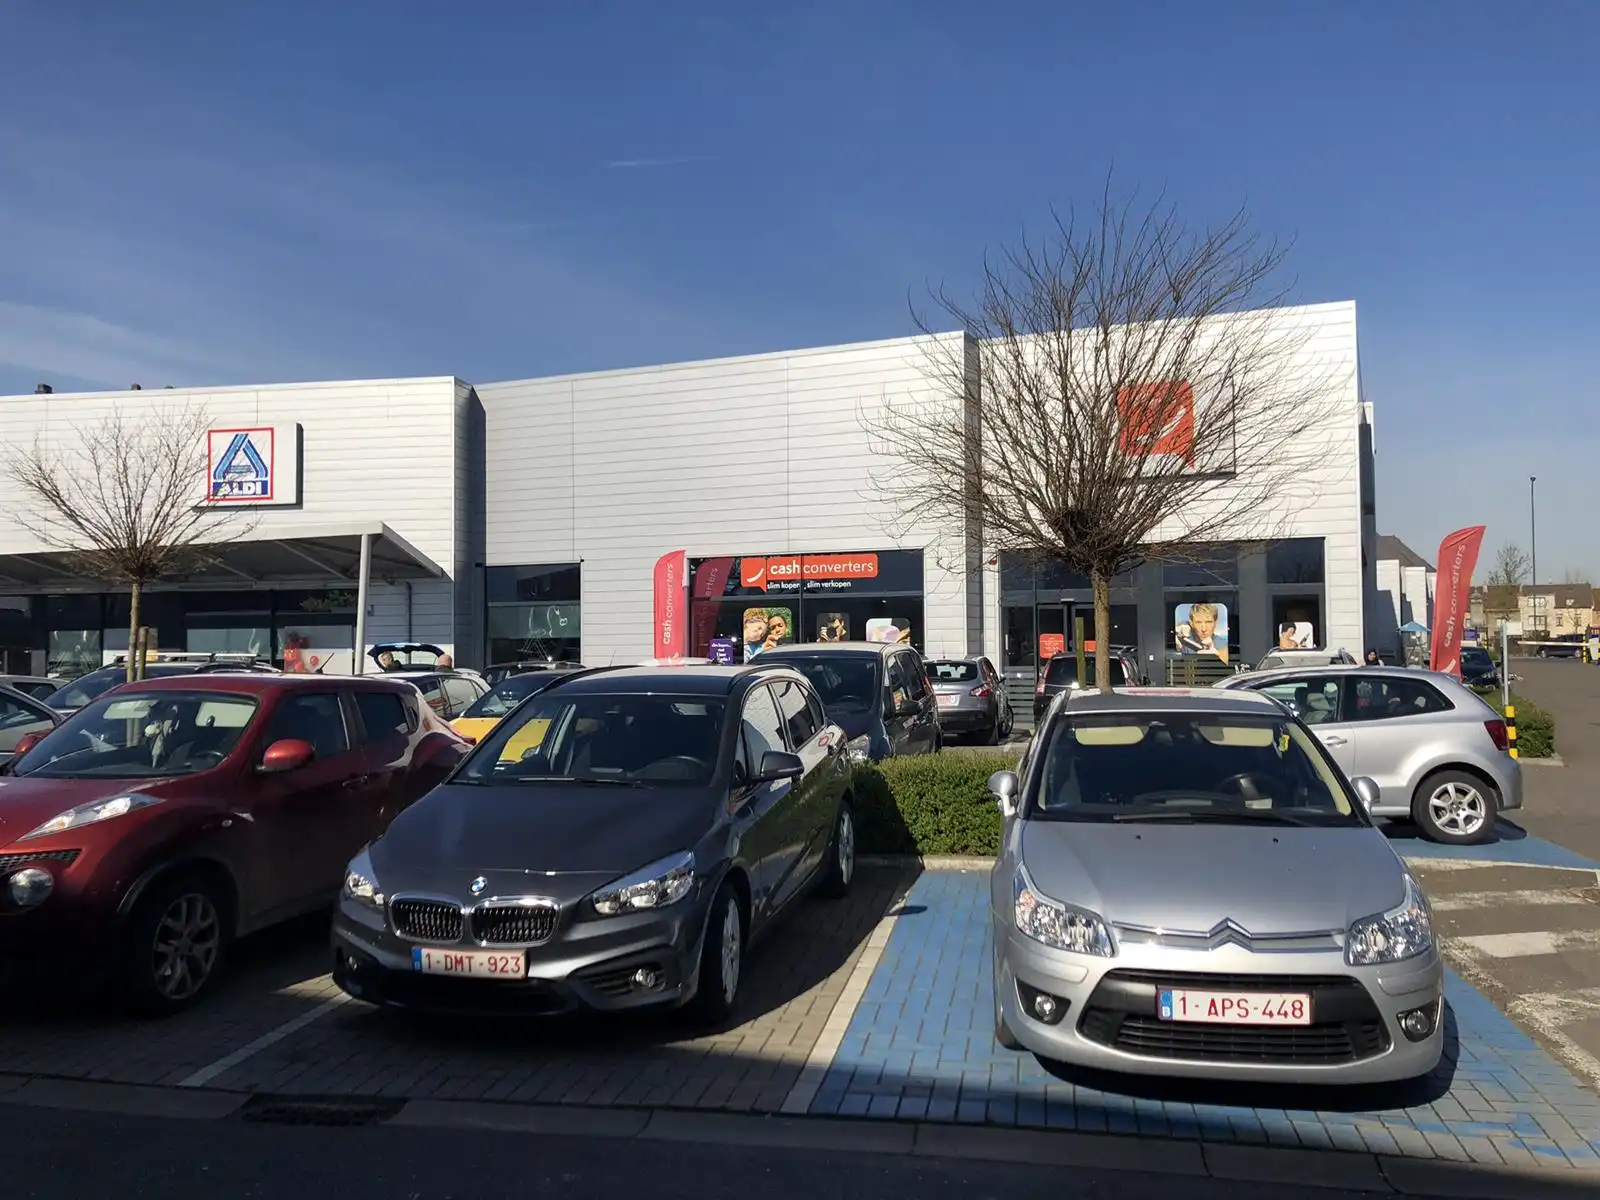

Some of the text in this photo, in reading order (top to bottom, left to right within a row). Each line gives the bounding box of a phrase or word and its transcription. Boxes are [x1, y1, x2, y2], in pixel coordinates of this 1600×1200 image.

[217, 480, 263, 496] ALDI
[770, 559, 874, 575] cash converters
[767, 581, 780, 590] slim
[806, 580, 820, 589] slim
[821, 579, 852, 589] verkopen
[662, 563, 674, 645] cash converters
[1444, 615, 1456, 648] cash
